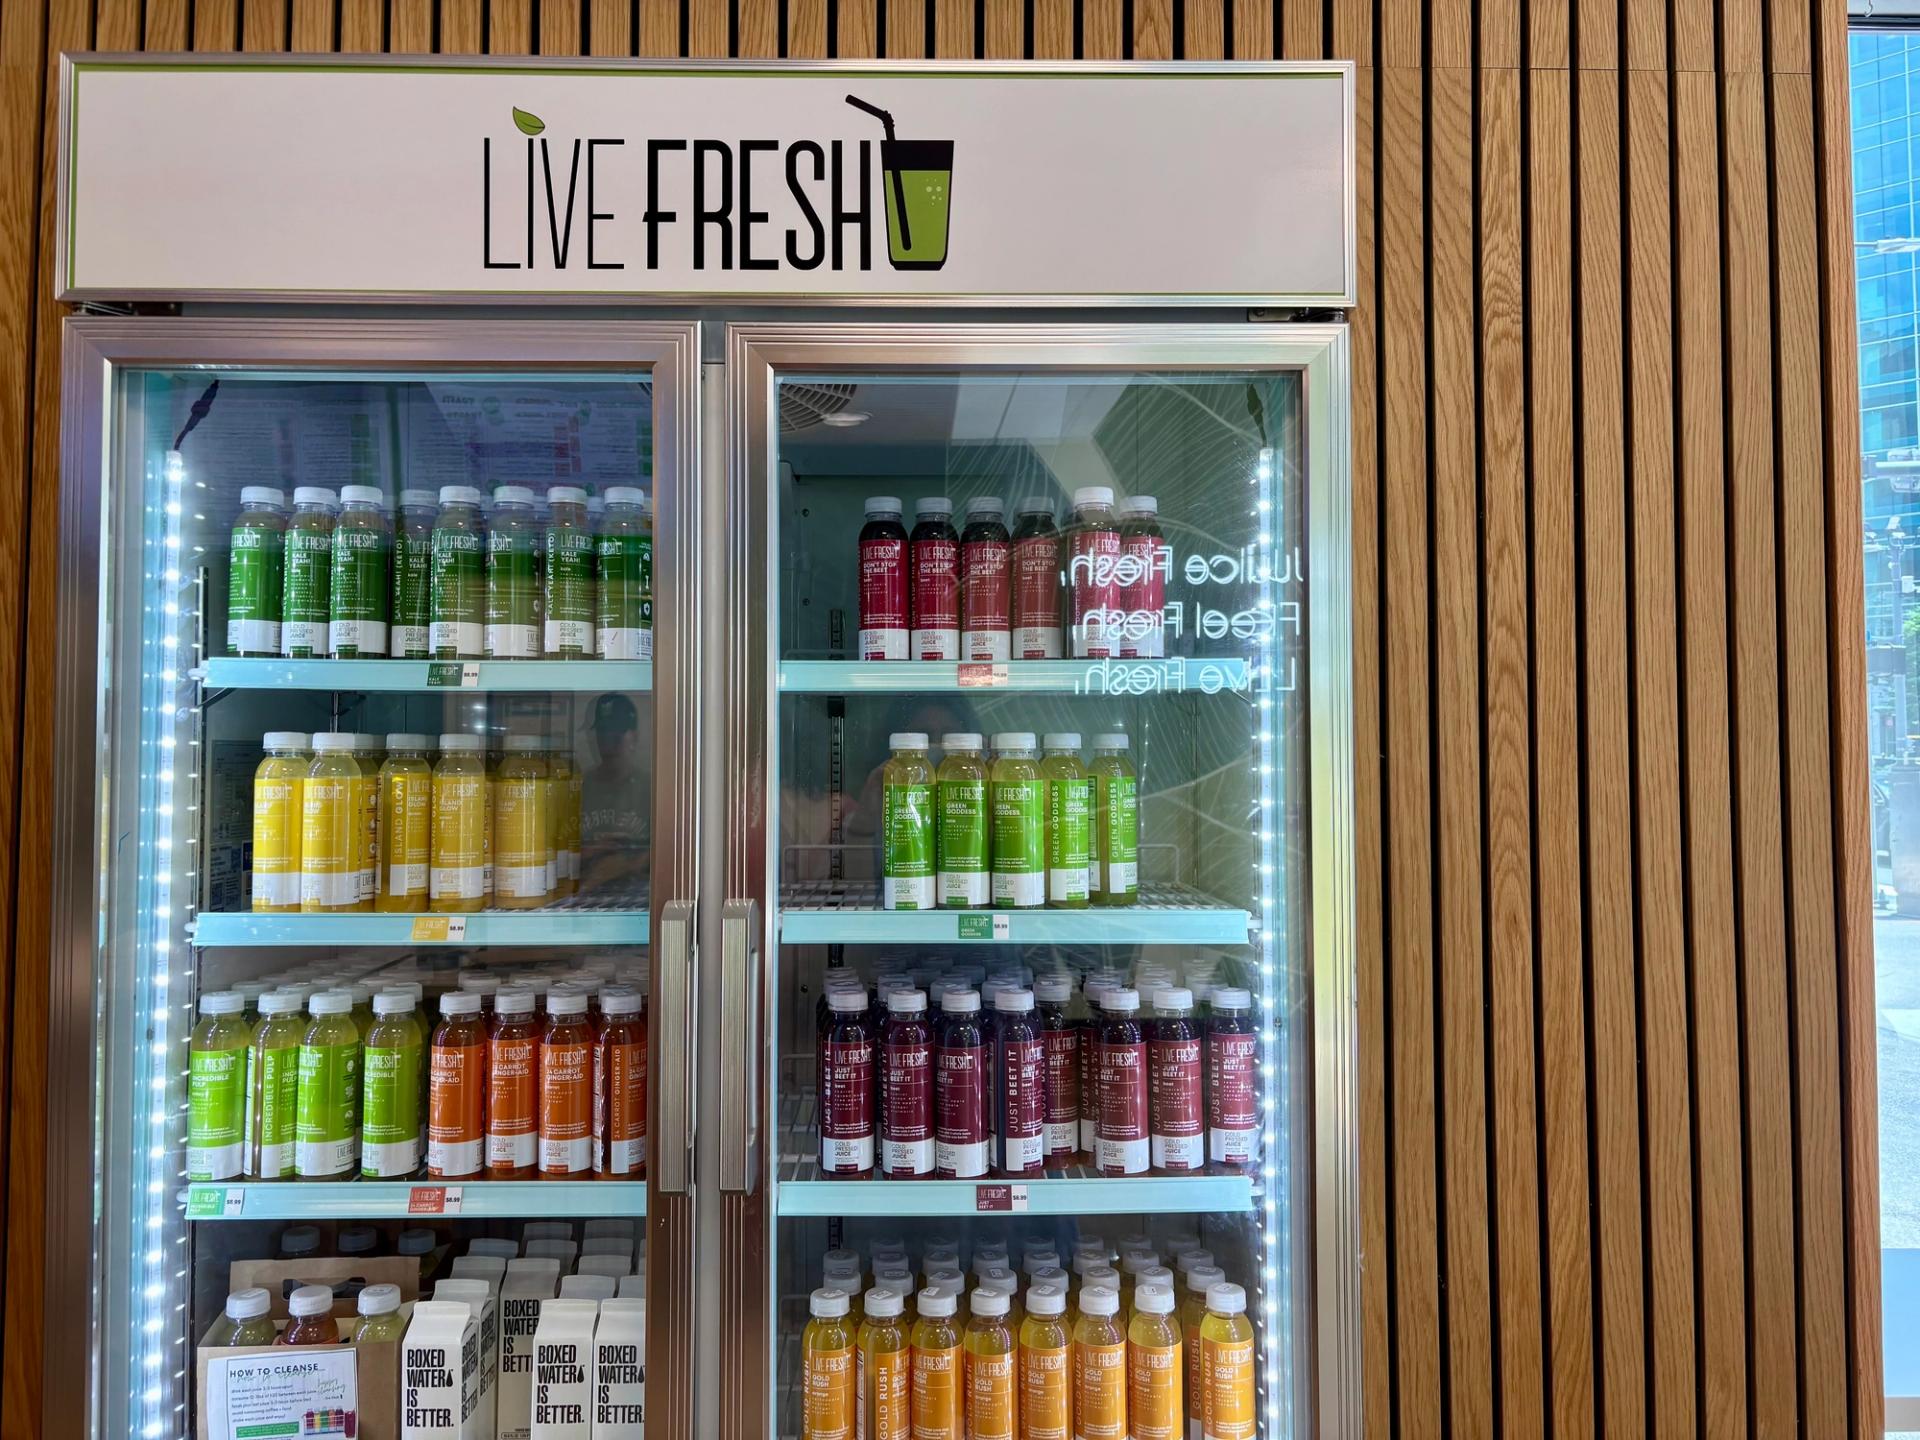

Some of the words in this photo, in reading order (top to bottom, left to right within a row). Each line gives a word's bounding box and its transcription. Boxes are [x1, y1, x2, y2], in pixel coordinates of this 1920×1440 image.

[484, 137, 625, 269] LIVE
[642, 139, 871, 271] FRESH
[451, 535, 474, 550] FRESH
[1022, 544, 1035, 558] LIVE
[1035, 544, 1055, 557] FRESH
[863, 547, 874, 560] LIVE
[874, 546, 895, 560] FRESH
[920, 547, 932, 560] LIVE
[932, 546, 951, 560] FRESH
[970, 549, 982, 561] LIVE
[982, 548, 1003, 561] FRESH
[394, 781, 404, 814] GLOW
[1004, 787, 1024, 801] FRESH
[394, 818, 403, 857] ISLAND
[1008, 1050, 1017, 1061] IT
[1161, 1048, 1176, 1062] LIVE
[1176, 1048, 1197, 1062] FRESH
[1211, 1040, 1218, 1052] IT
[370, 1054, 394, 1069] FRESH
[437, 1054, 457, 1068] FRESH
[560, 1050, 581, 1066] FRESH
[834, 1050, 848, 1065] LIVE
[849, 1048, 868, 1064] FRESH
[889, 1052, 902, 1067] LIVE
[902, 1051, 923, 1067] FRESH
[945, 1055, 967, 1070] FRESH
[1100, 1052, 1111, 1066] LIVE
[1112, 1052, 1133, 1067] FRESH
[267, 1055, 275, 1080] PULP
[1211, 1058, 1219, 1086] BEET
[192, 1074, 229, 1082] INCREDIBLE
[1009, 1067, 1017, 1096] BEET
[265, 1083, 274, 1141] INCREDIBLE
[1212, 1092, 1220, 1122] JUST
[1010, 1102, 1018, 1132] JUST
[504, 1299, 540, 1318] BOXED
[481, 1309, 495, 1339] BOXED
[462, 1333, 476, 1364] BOXED
[503, 1337, 514, 1355] IS
[538, 1344, 577, 1364] BOXED
[598, 1345, 637, 1364] BOXED
[1215, 1348, 1228, 1363] LIVE
[1228, 1347, 1251, 1363] FRESH
[407, 1349, 445, 1368] BOXED
[462, 1352, 477, 1384] WATER
[480, 1358, 486, 1376] IS
[812, 1357, 825, 1372] LIVE
[826, 1356, 848, 1372] FRESH
[924, 1356, 944, 1370] FRESH
[229, 1369, 254, 1378] HOW
[257, 1367, 270, 1376] TO
[274, 1363, 319, 1374] CLEANSE
[406, 1369, 446, 1388] WATER
[537, 1365, 578, 1384] WATER
[598, 1365, 638, 1384] WATER
[1085, 1368, 1102, 1376] GOLD
[880, 1367, 888, 1400] RUSH
[975, 1378, 993, 1386] GOLD
[406, 1388, 418, 1407] IS
[462, 1383, 467, 1401] IS
[537, 1385, 549, 1404] IS
[597, 1385, 609, 1404] IS
[536, 1405, 585, 1424] BETTER.
[1205, 1391, 1213, 1425] GOLD
[406, 1408, 455, 1428] BETTER.
[880, 1405, 888, 1440] GOLD
